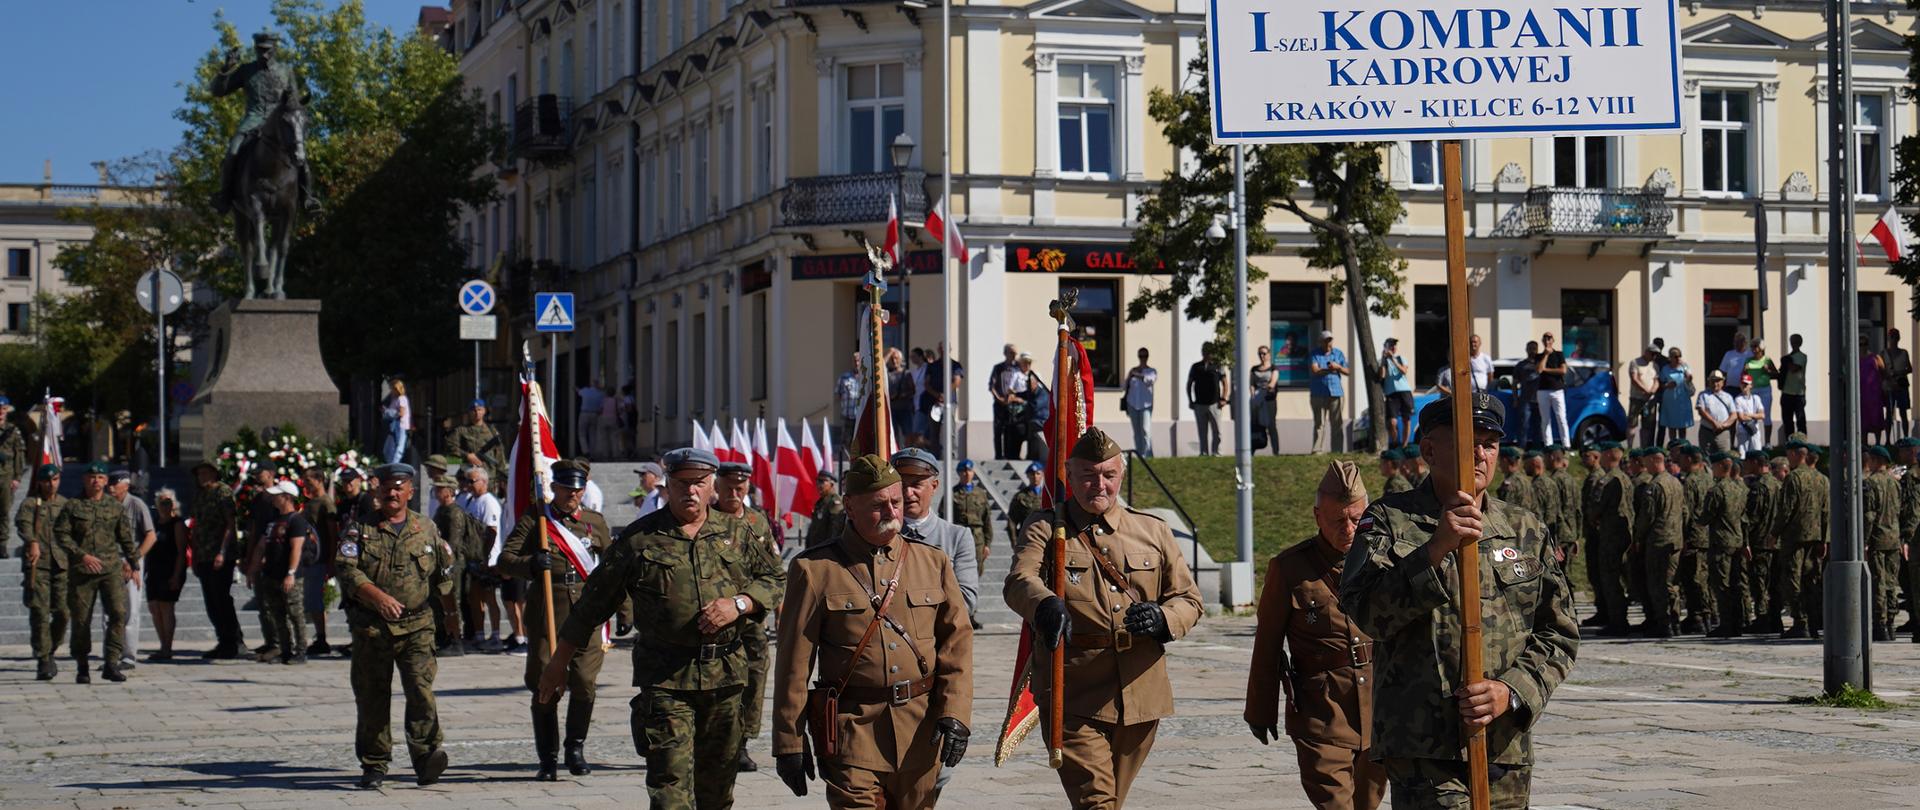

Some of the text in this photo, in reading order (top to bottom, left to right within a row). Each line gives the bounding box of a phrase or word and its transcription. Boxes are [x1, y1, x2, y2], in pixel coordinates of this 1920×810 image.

[1319, 7, 1643, 51] KOMPANII
[1328, 55, 1573, 87] KADROWEJ
[1265, 95, 1396, 121] KRAKÓW
[1421, 98, 1524, 118] KIELCE
[1531, 97, 1579, 116] 6-12
[1584, 96, 1636, 115] VIII
